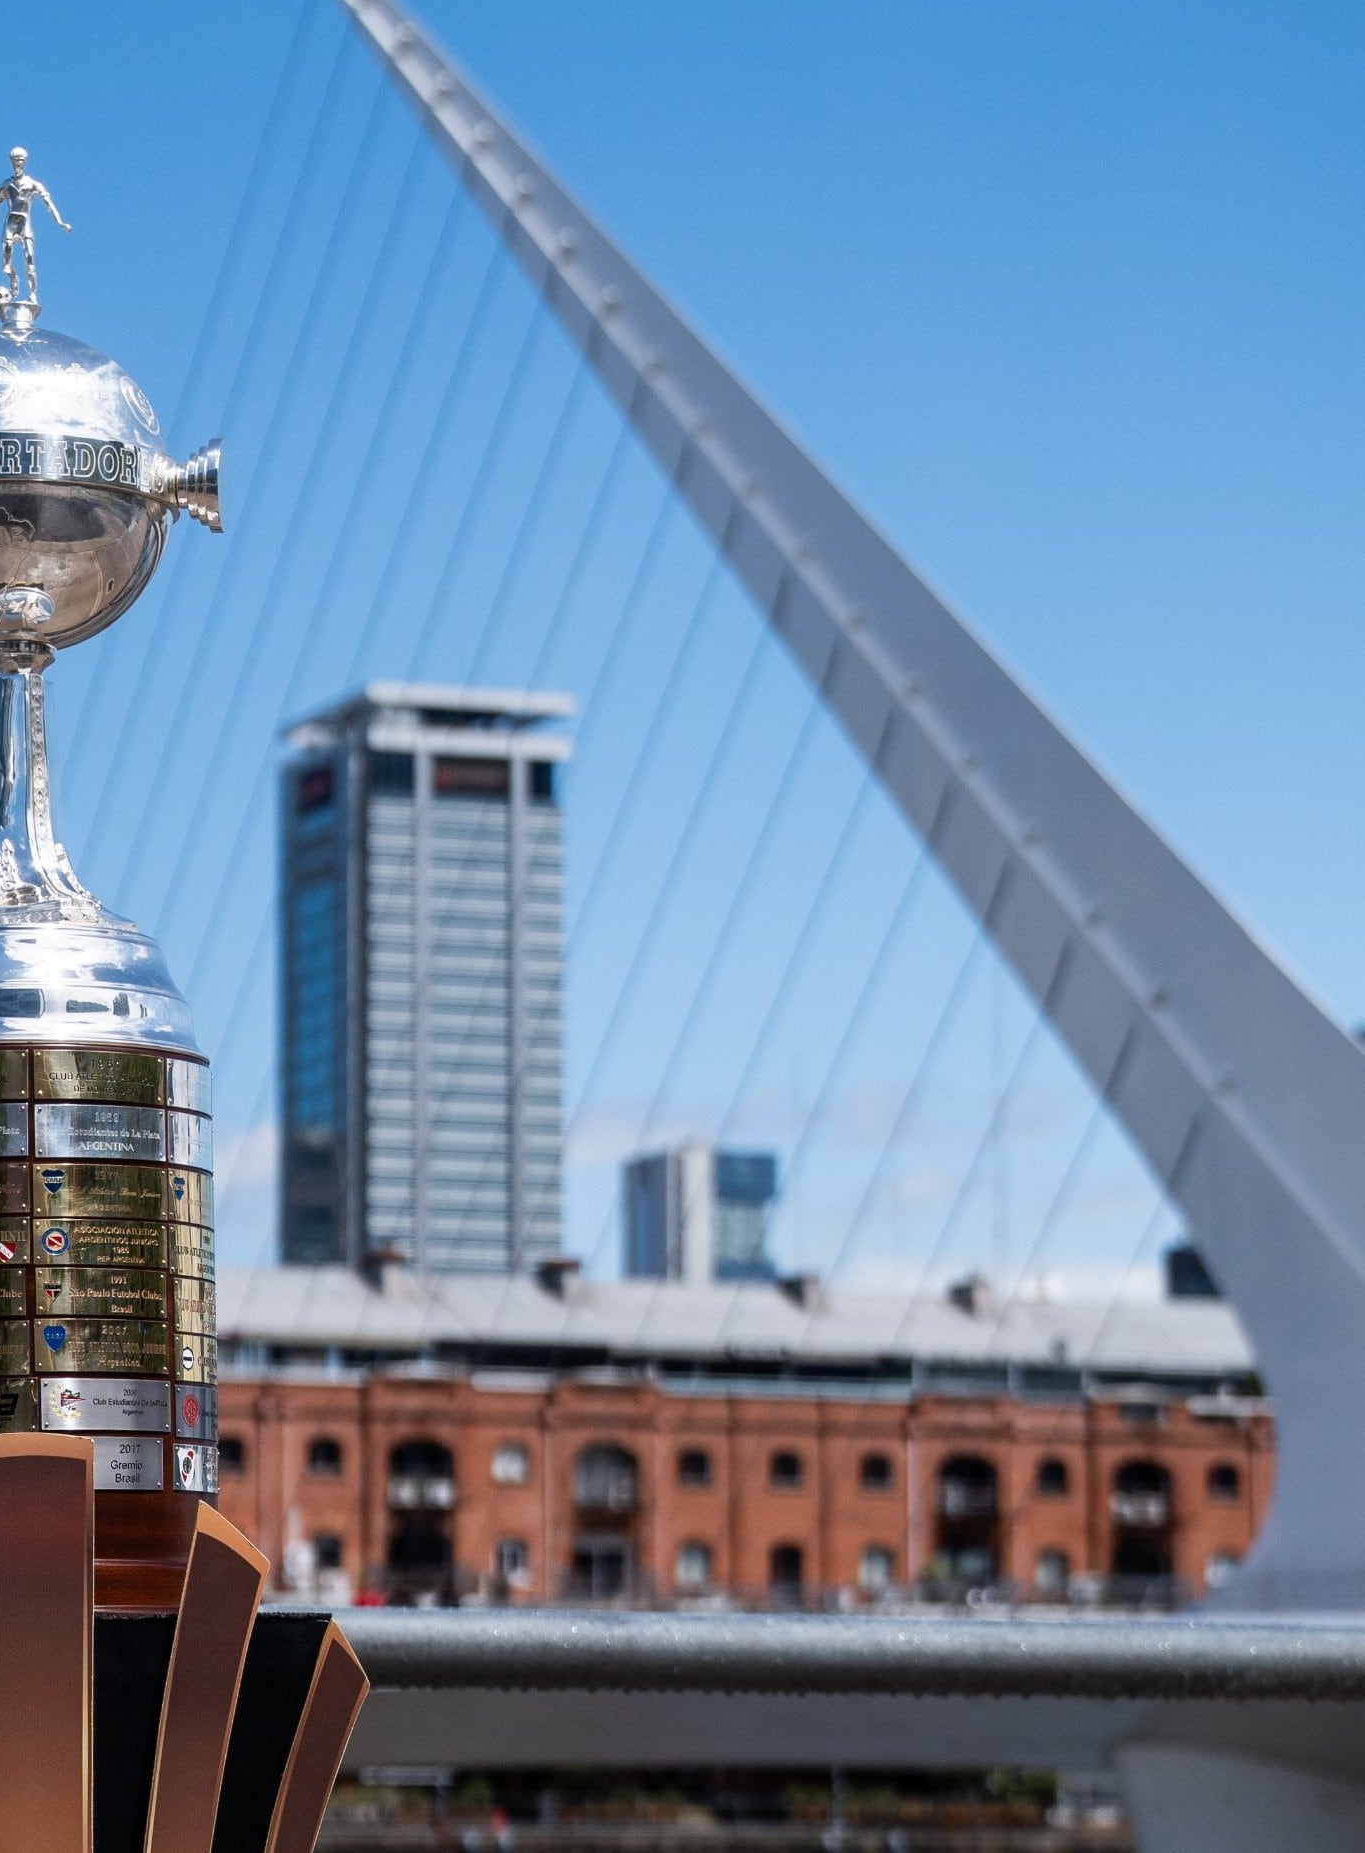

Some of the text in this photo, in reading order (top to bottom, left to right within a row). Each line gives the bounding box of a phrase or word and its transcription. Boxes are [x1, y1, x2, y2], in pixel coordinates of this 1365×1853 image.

[48, 1072, 74, 1081] CLUB
[79, 1142, 134, 1152] ARGENTINA
[78, 1236, 129, 1244] ARGENTINOS
[87, 1287, 111, 1298] Paulo
[111, 1288, 140, 1299] Futebol
[141, 1289, 163, 1301] Clube
[111, 1305, 133, 1314] Brasil
[97, 1355, 142, 1369] Argentina
[93, 1398, 107, 1406] Club
[119, 1444, 142, 1454] 2017
[110, 1460, 143, 1470] Gremio
[115, 1473, 141, 1483] Brasil
